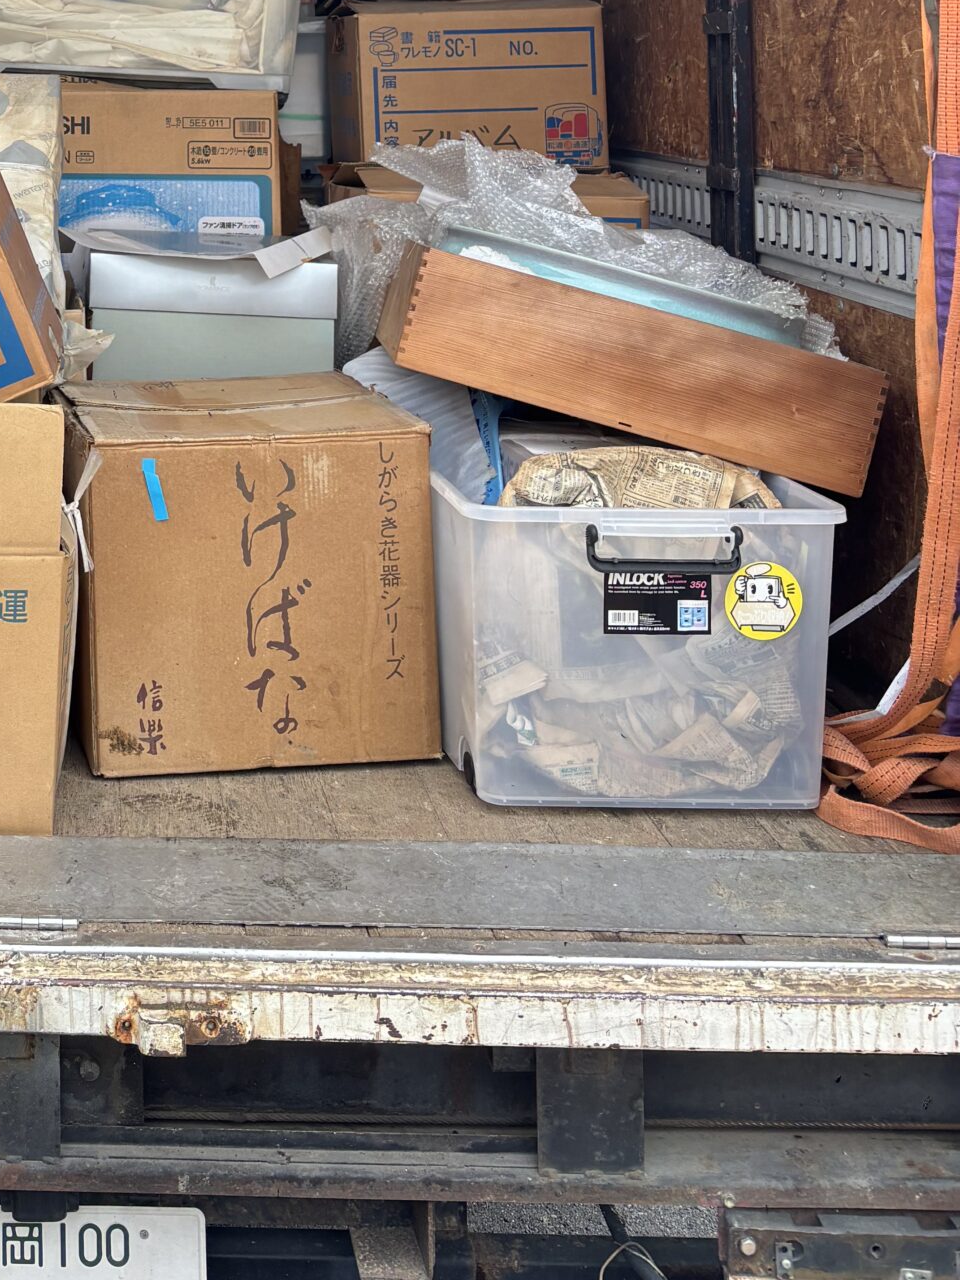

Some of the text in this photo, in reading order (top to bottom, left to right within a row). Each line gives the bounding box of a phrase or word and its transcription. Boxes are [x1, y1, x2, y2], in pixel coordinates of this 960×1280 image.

[509, 40, 538, 56] NO.
[378, 442, 405, 680] しがらき花器シリーズ
[608, 573, 665, 585] INLOCK
[235, 459, 313, 735] いけばな
[60, 1222, 130, 1268] 100
